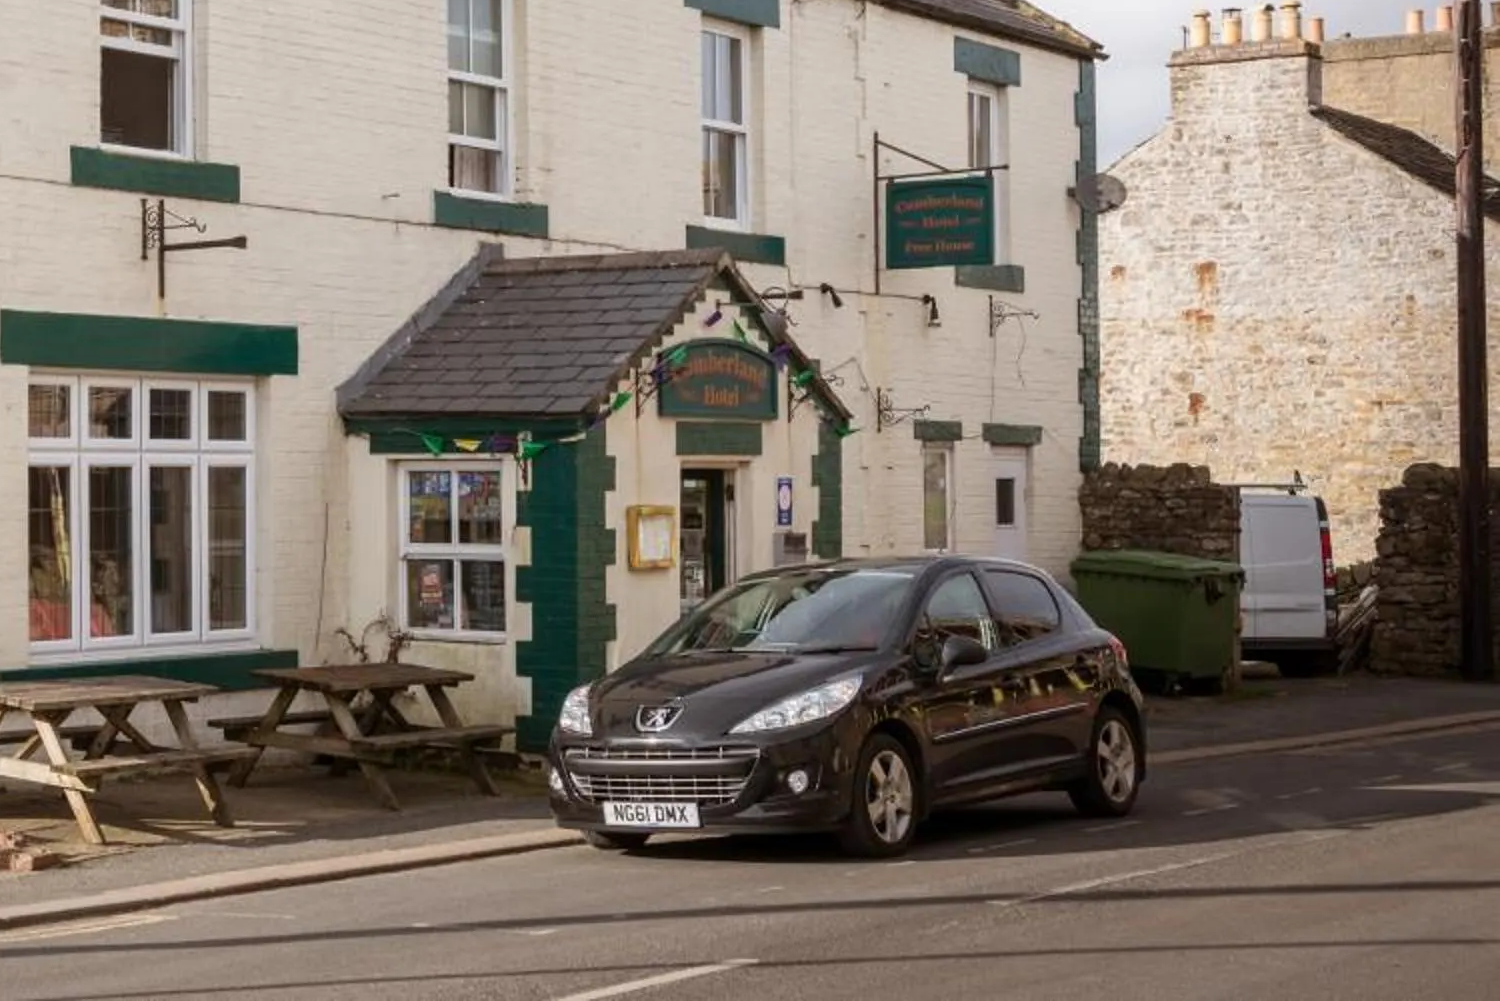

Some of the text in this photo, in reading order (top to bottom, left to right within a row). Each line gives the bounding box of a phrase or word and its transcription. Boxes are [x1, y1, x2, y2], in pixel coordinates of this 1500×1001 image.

[921, 215, 960, 229] Hotel
[703, 385, 739, 407] Hotel
[613, 804, 689, 823] NG61 DMX
